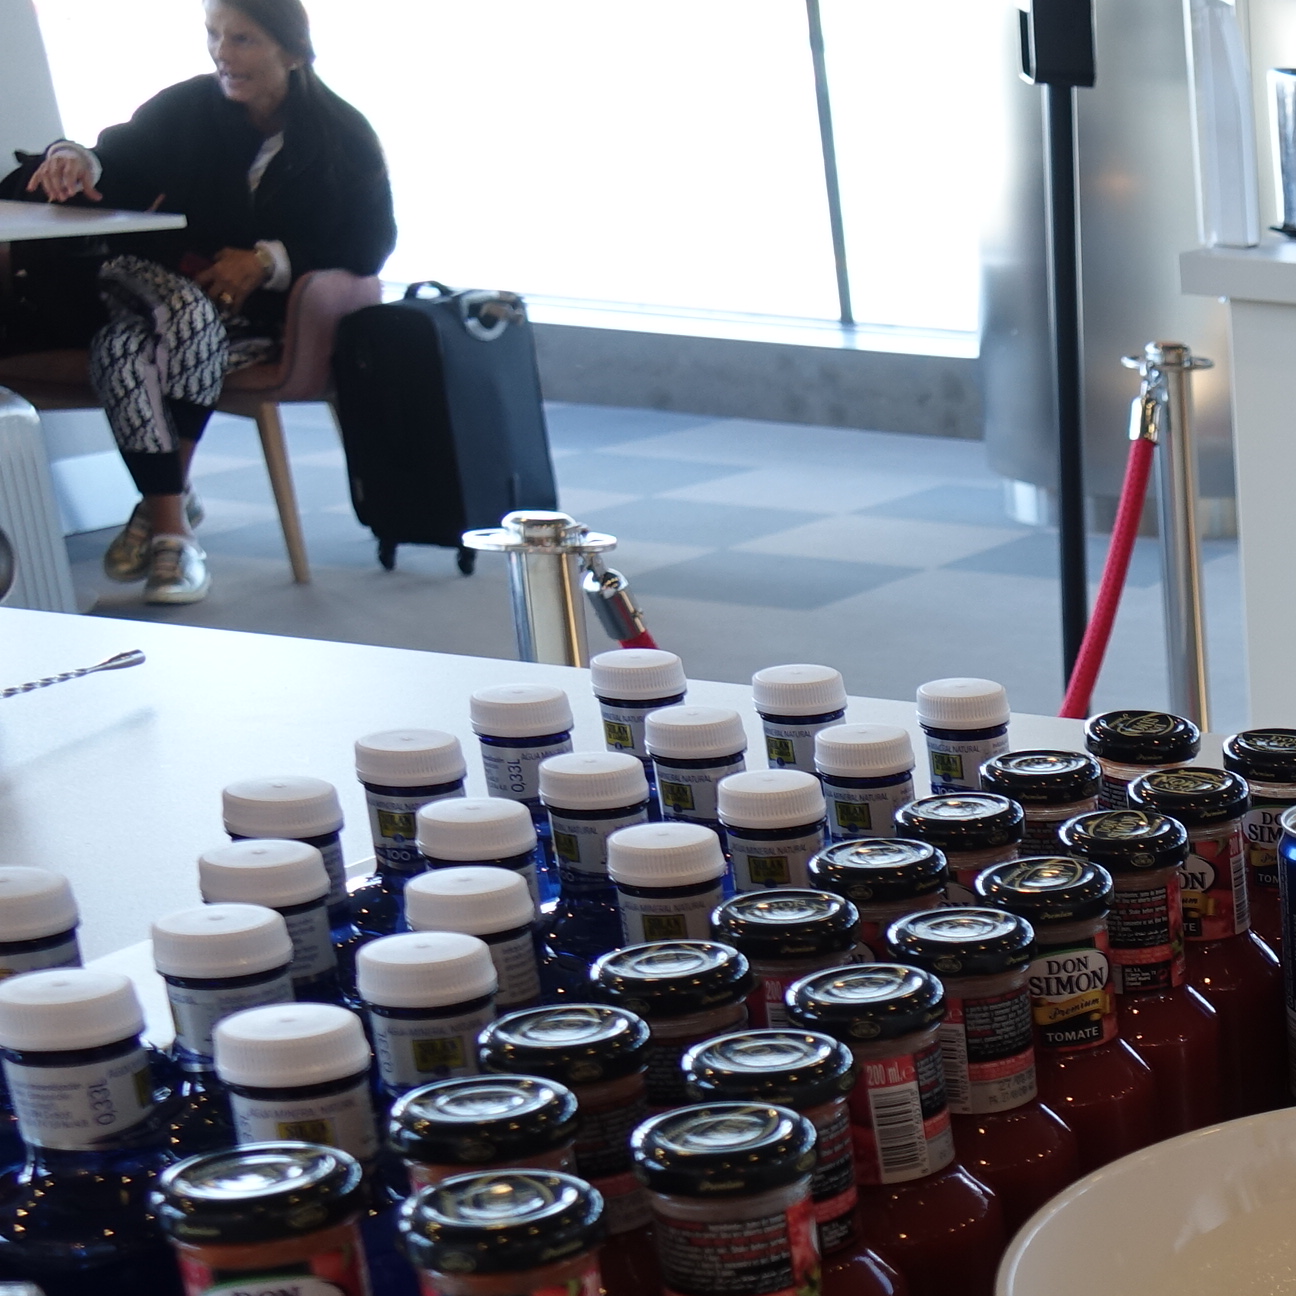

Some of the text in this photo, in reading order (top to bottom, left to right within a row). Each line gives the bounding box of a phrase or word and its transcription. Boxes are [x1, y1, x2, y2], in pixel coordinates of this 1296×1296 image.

[788, 729, 812, 738] NATURAL
[508, 759, 525, 793] 0,33L
[1248, 823, 1283, 844] SIM
[1046, 956, 1090, 975] DON
[765, 980, 782, 998] 200
[1029, 972, 1105, 997] SIMON
[1049, 998, 1100, 1020] Premium
[1046, 1027, 1099, 1043] TOMATE
[867, 1064, 885, 1086] 200
